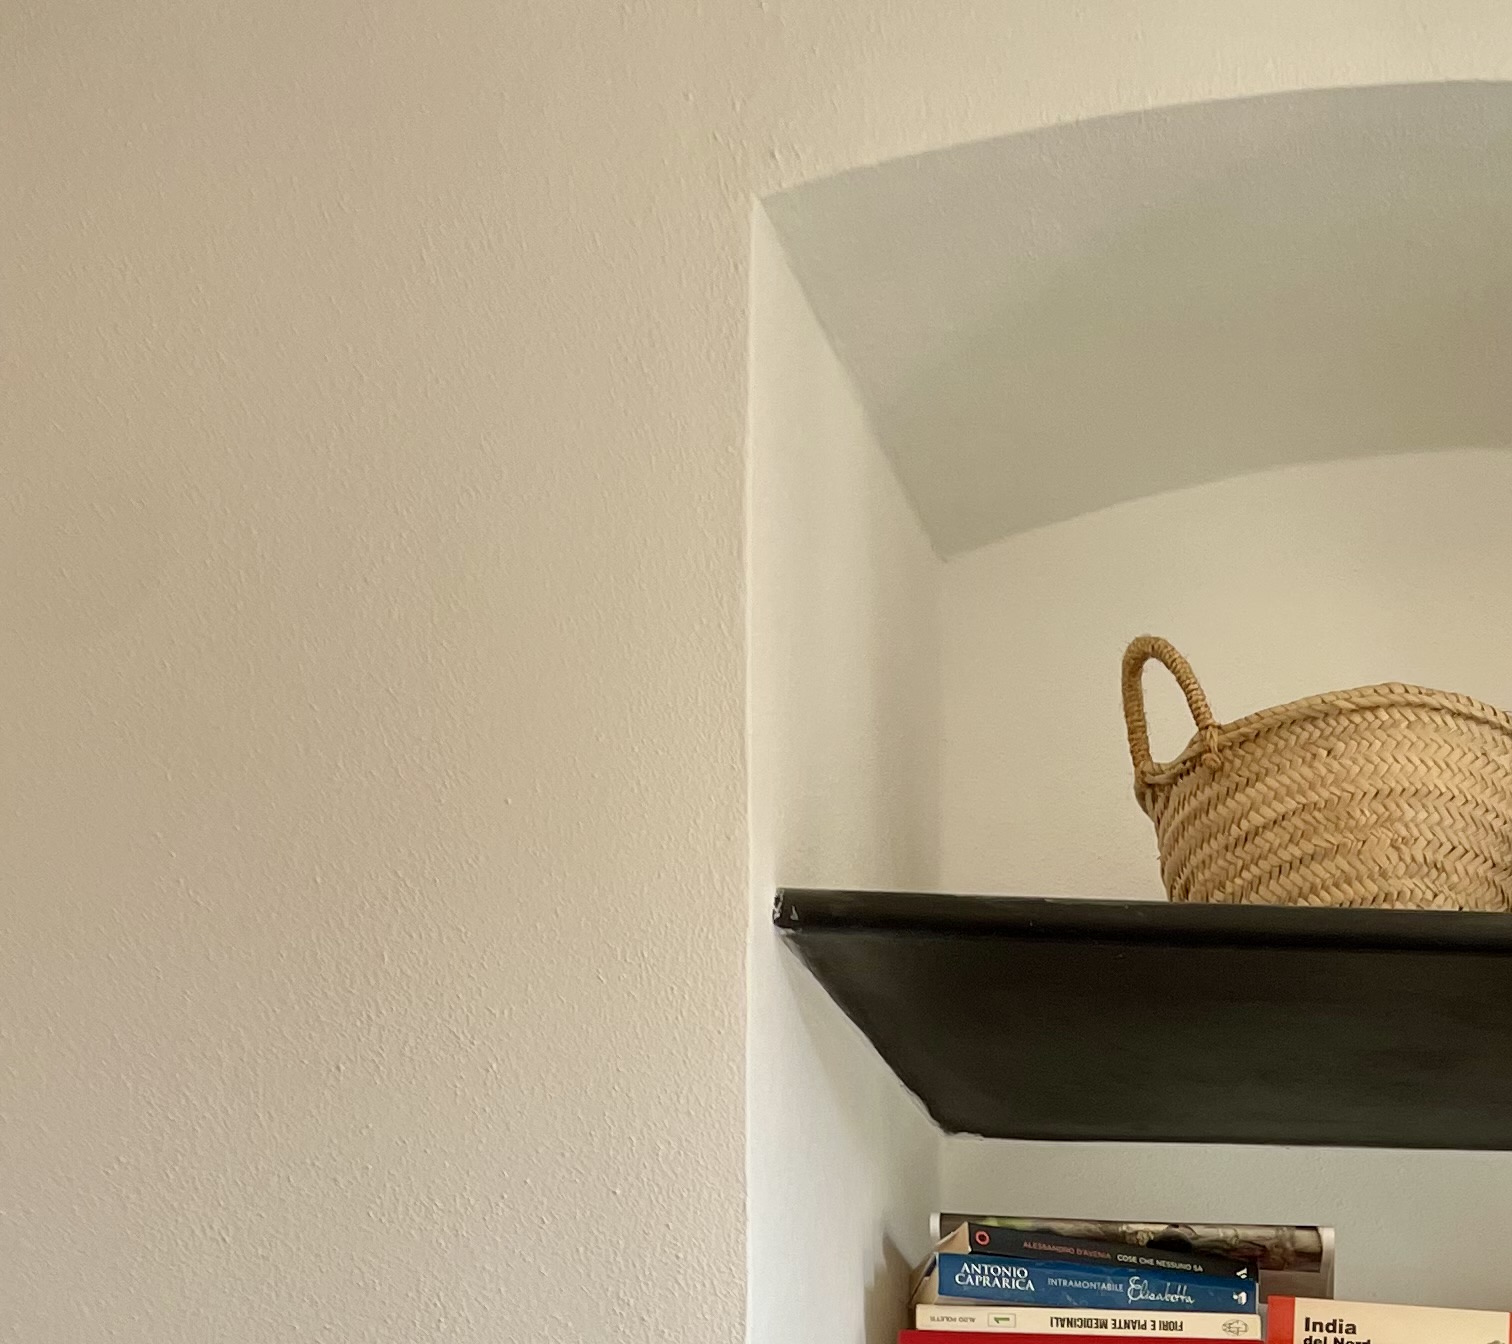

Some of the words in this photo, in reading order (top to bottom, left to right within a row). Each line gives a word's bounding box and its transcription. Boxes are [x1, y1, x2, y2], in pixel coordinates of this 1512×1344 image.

[960, 1262, 1028, 1279] ANTONIO
[1116, 1253, 1137, 1264] COSE
[1193, 1264, 1204, 1273] SA
[955, 1273, 1035, 1291] CAPRARICA
[1047, 1277, 1124, 1293] INTRAMONTABILE
[1050, 1316, 1108, 1329] MEDICINALI
[1111, 1318, 1147, 1331] PIANTE
[1151, 1320, 1156, 1331] E
[1158, 1320, 1184, 1332] FIORI
[1304, 1317, 1357, 1335] India
